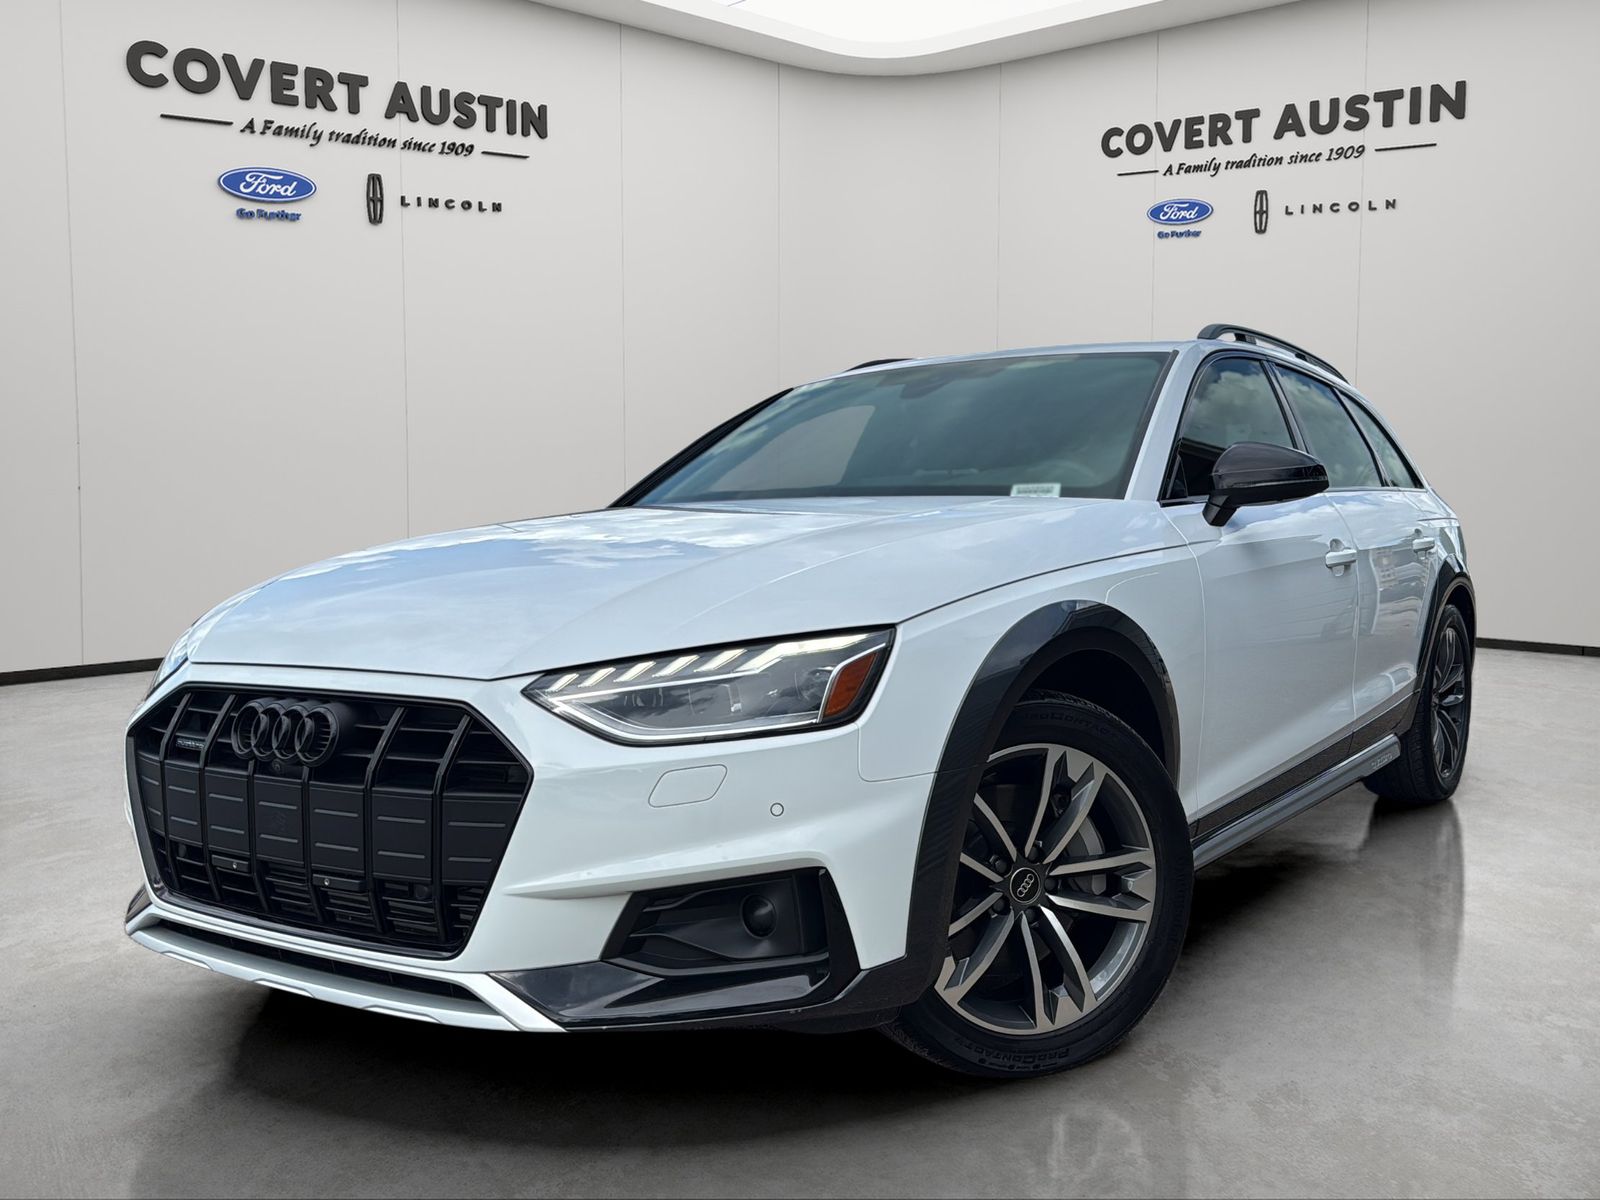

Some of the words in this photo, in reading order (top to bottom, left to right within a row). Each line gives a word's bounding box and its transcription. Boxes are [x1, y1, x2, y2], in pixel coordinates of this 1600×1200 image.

[125, 40, 369, 116] COVERT
[384, 80, 549, 140] AUSTIN
[1100, 107, 1261, 159] COVERT
[1272, 80, 1467, 141] AUSTIN
[239, 117, 257, 135] A
[259, 119, 324, 148] Family
[327, 128, 399, 149] tradition
[400, 134, 437, 154] since
[438, 140, 476, 158] 1909
[1162, 163, 1175, 177] A
[1175, 156, 1222, 178] Family
[1223, 152, 1284, 172] tradition
[1287, 150, 1324, 165] since
[1325, 144, 1367, 161] 1909
[239, 172, 298, 197] Ford
[236, 207, 256, 220] Go
[400, 195, 503, 213] LINCOLN
[1284, 198, 1398, 216] LINCOLN
[1157, 230, 1171, 240] Go
